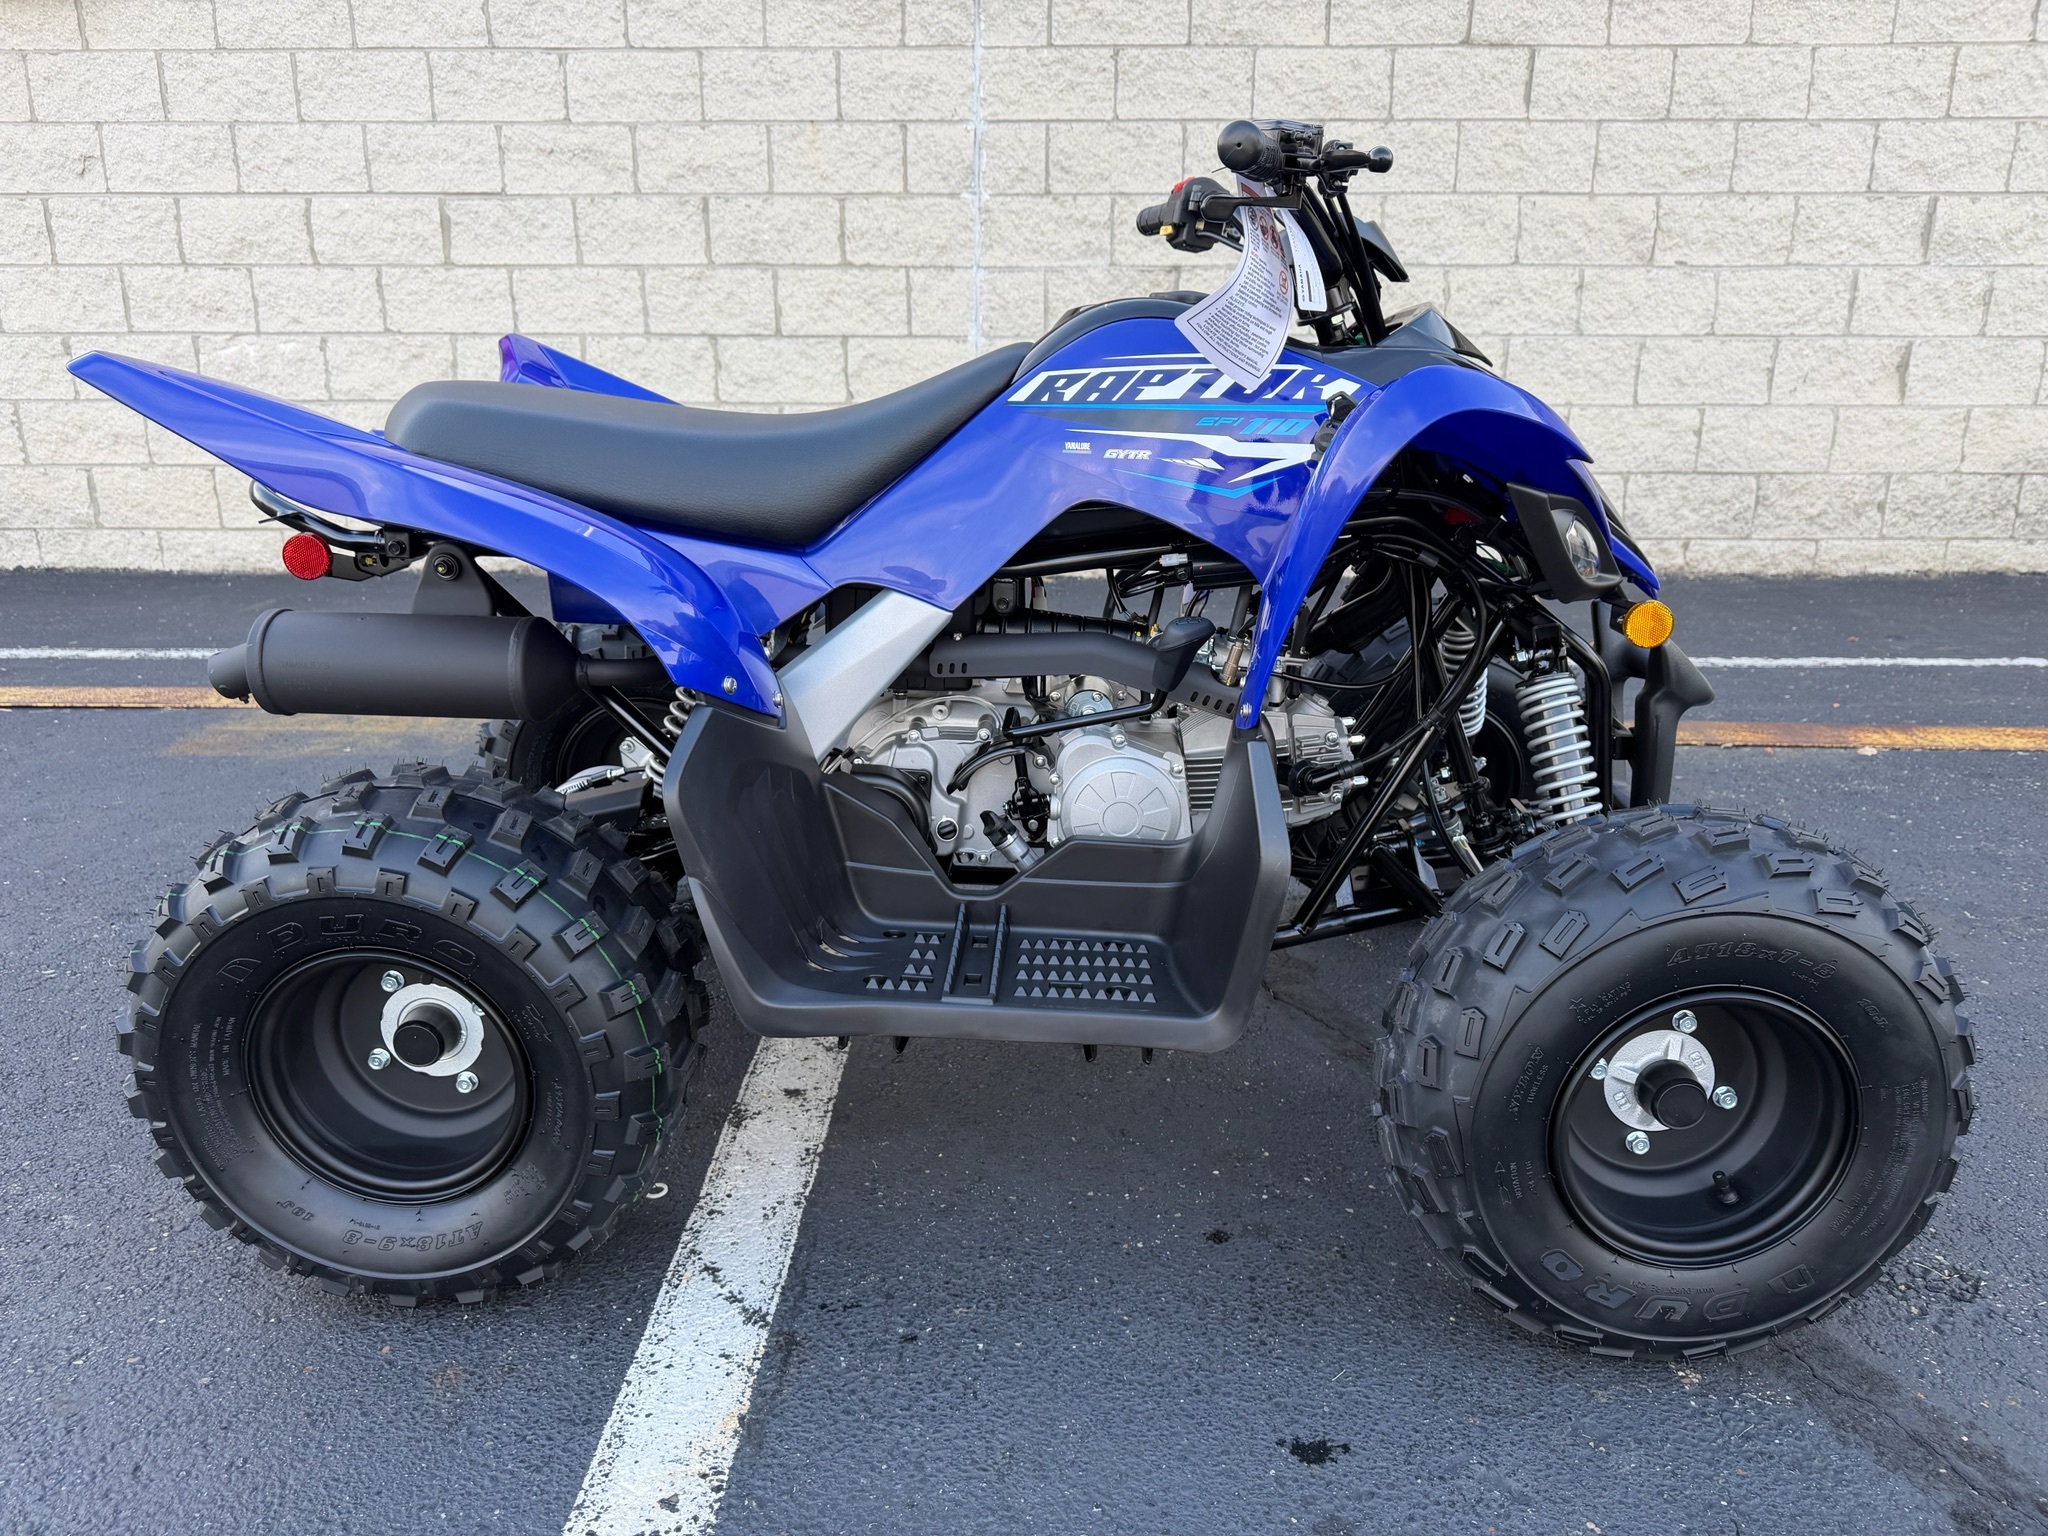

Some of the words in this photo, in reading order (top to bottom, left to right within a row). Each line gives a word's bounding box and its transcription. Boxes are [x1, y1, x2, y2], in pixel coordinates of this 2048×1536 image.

[1196, 417, 1244, 426] EFI
[1240, 418, 1314, 435] 110
[1103, 449, 1152, 460] GYTR
[342, 1221, 484, 1252] AT18x9-8
[1540, 1248, 1750, 1322] DURO
